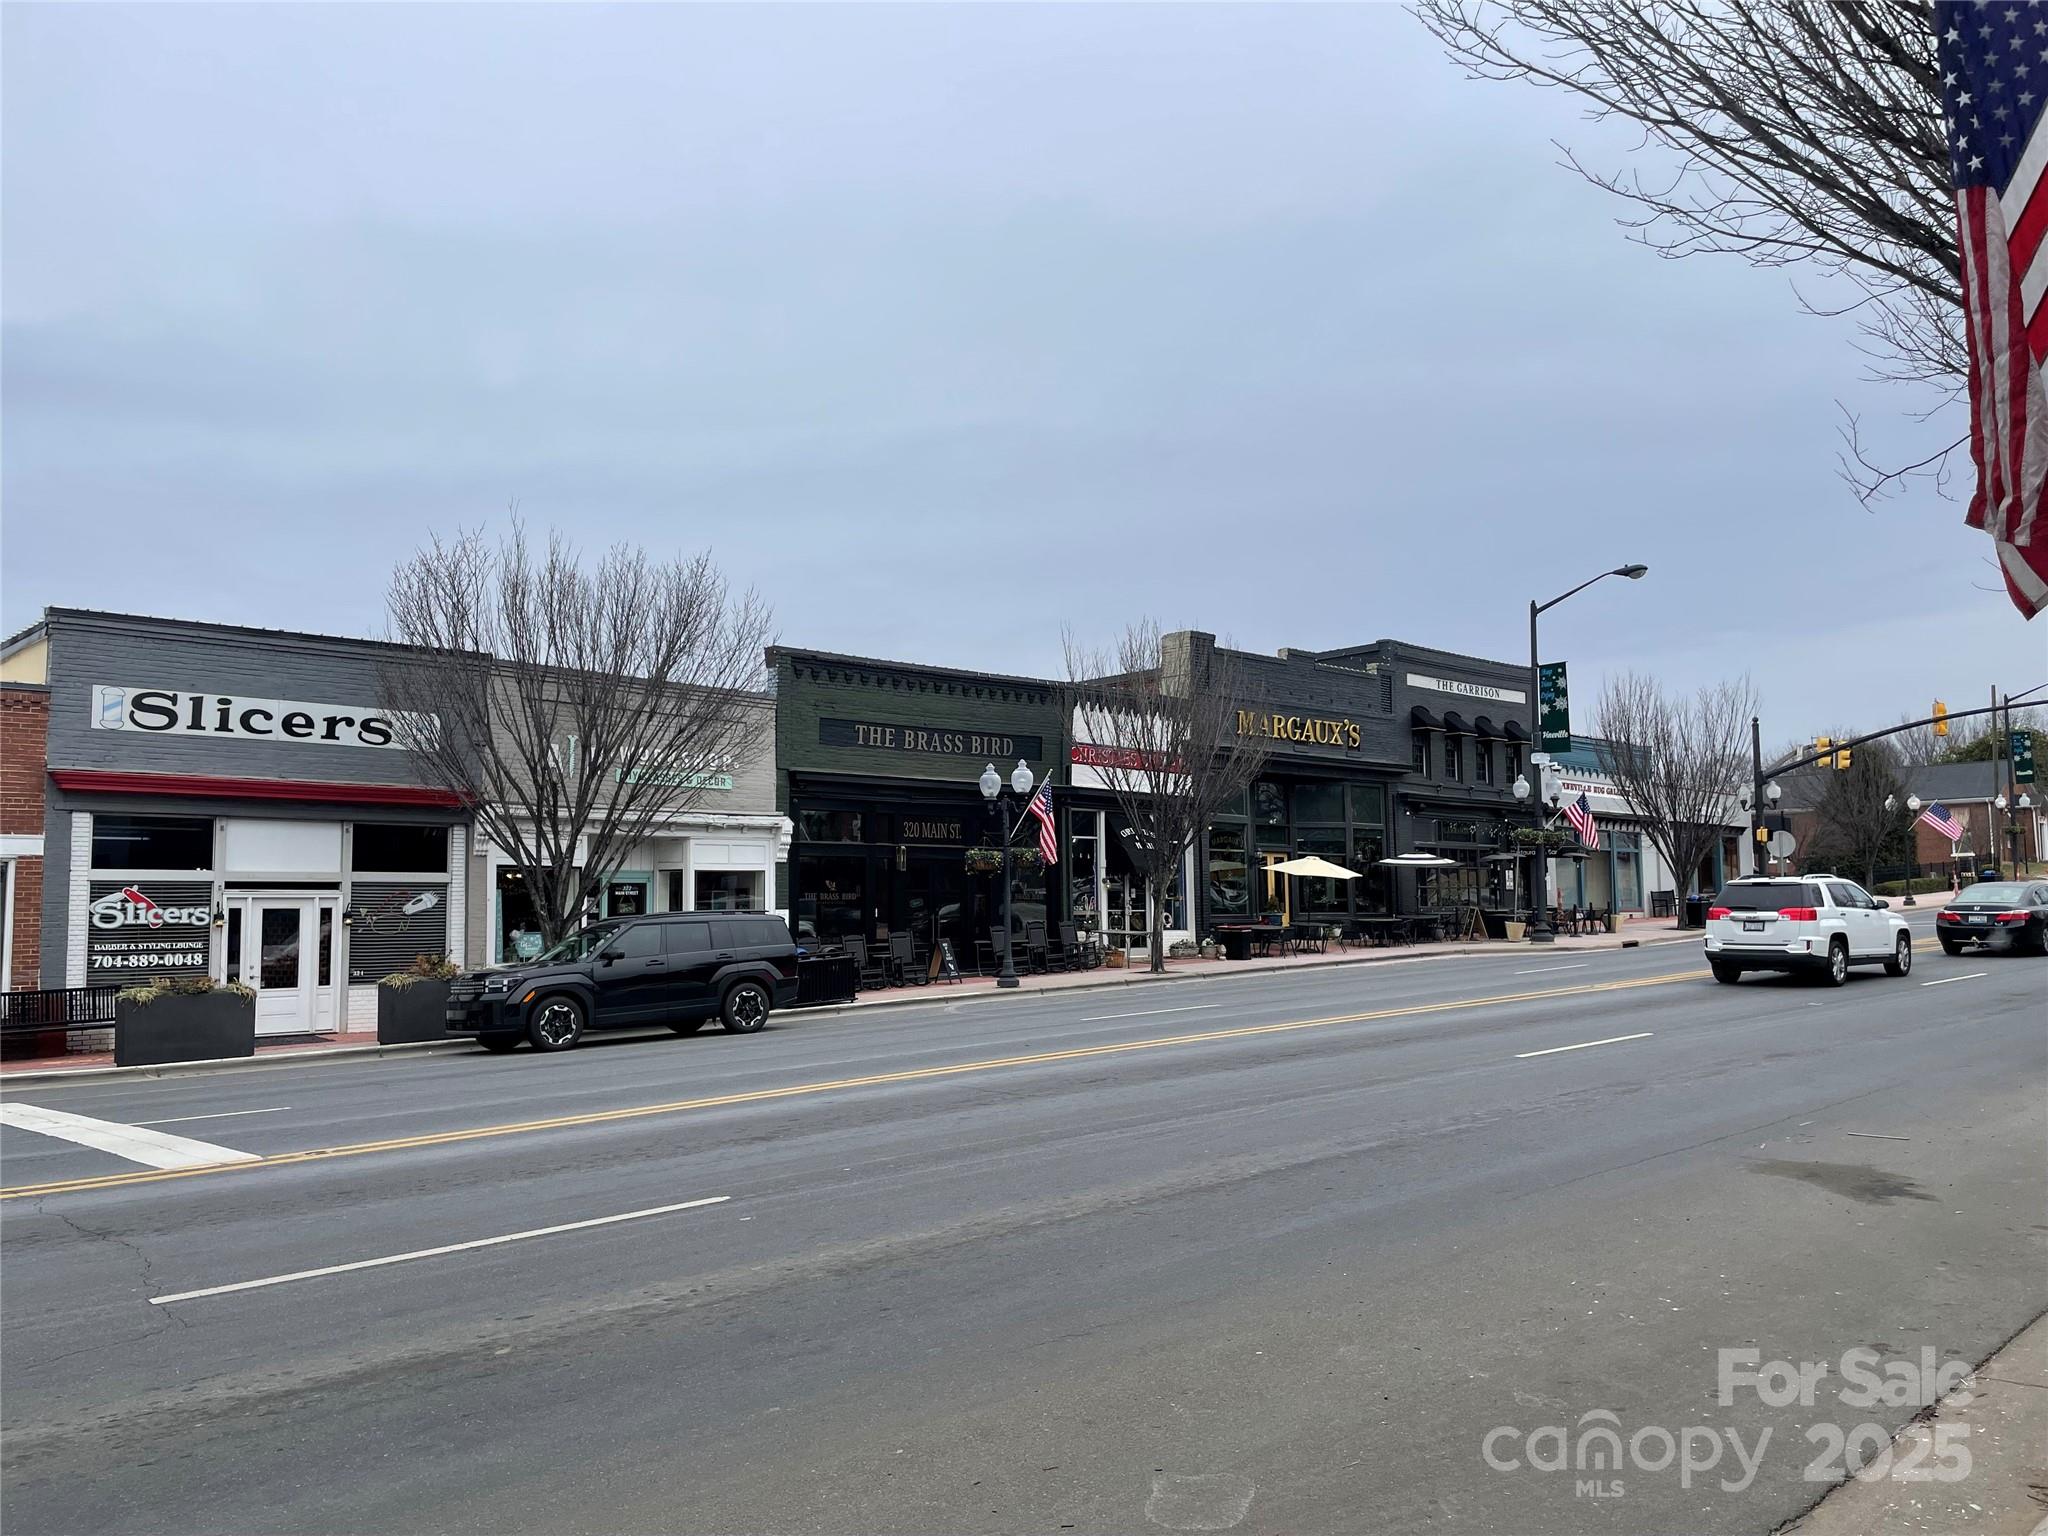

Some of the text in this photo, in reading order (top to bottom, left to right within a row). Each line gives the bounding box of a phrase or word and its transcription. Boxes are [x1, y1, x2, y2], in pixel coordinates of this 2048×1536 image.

[1436, 680, 1500, 698] THE GARRISON
[129, 691, 394, 746] Slicers
[1236, 710, 1361, 747] MARGAUX'S
[855, 724, 1014, 756] THE BRASS BIRD
[903, 821, 962, 839] 320 MAIN ST.
[92, 901, 210, 929] Slicers
[94, 943, 128, 951] BARBER
[138, 942, 171, 950] STYLING
[91, 953, 203, 968] 704-889-0048
